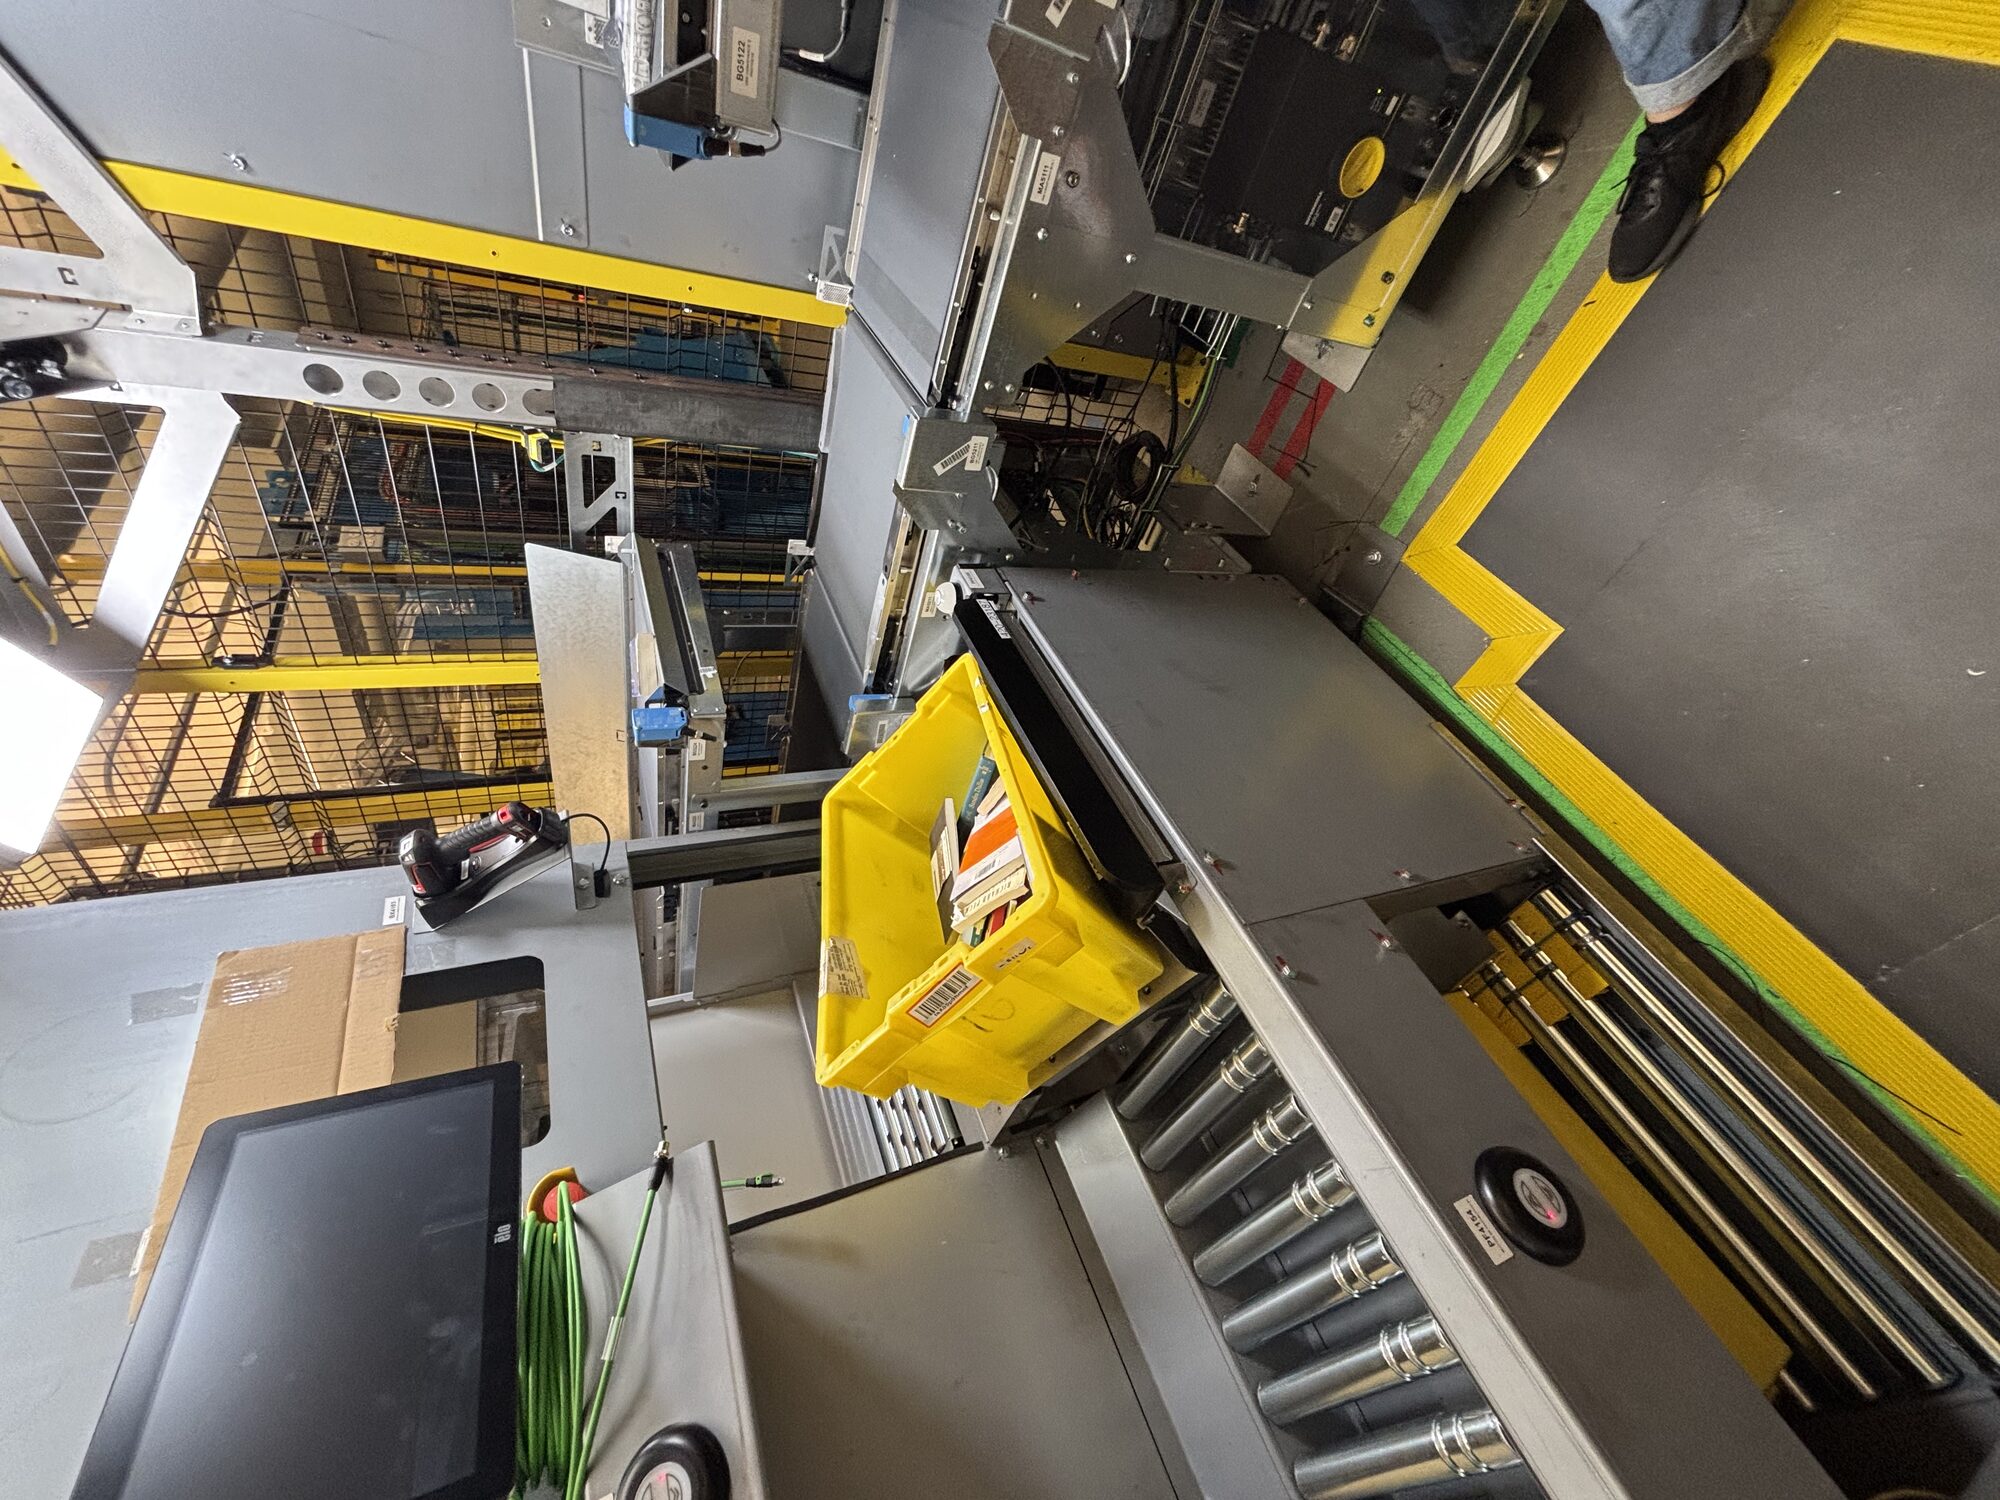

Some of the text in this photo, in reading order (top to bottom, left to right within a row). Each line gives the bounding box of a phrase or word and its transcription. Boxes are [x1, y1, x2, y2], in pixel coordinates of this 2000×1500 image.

[736, 41, 745, 81] BG5122
[494, 1224, 511, 1244] elo
[1466, 1208, 1496, 1248] PF4154
